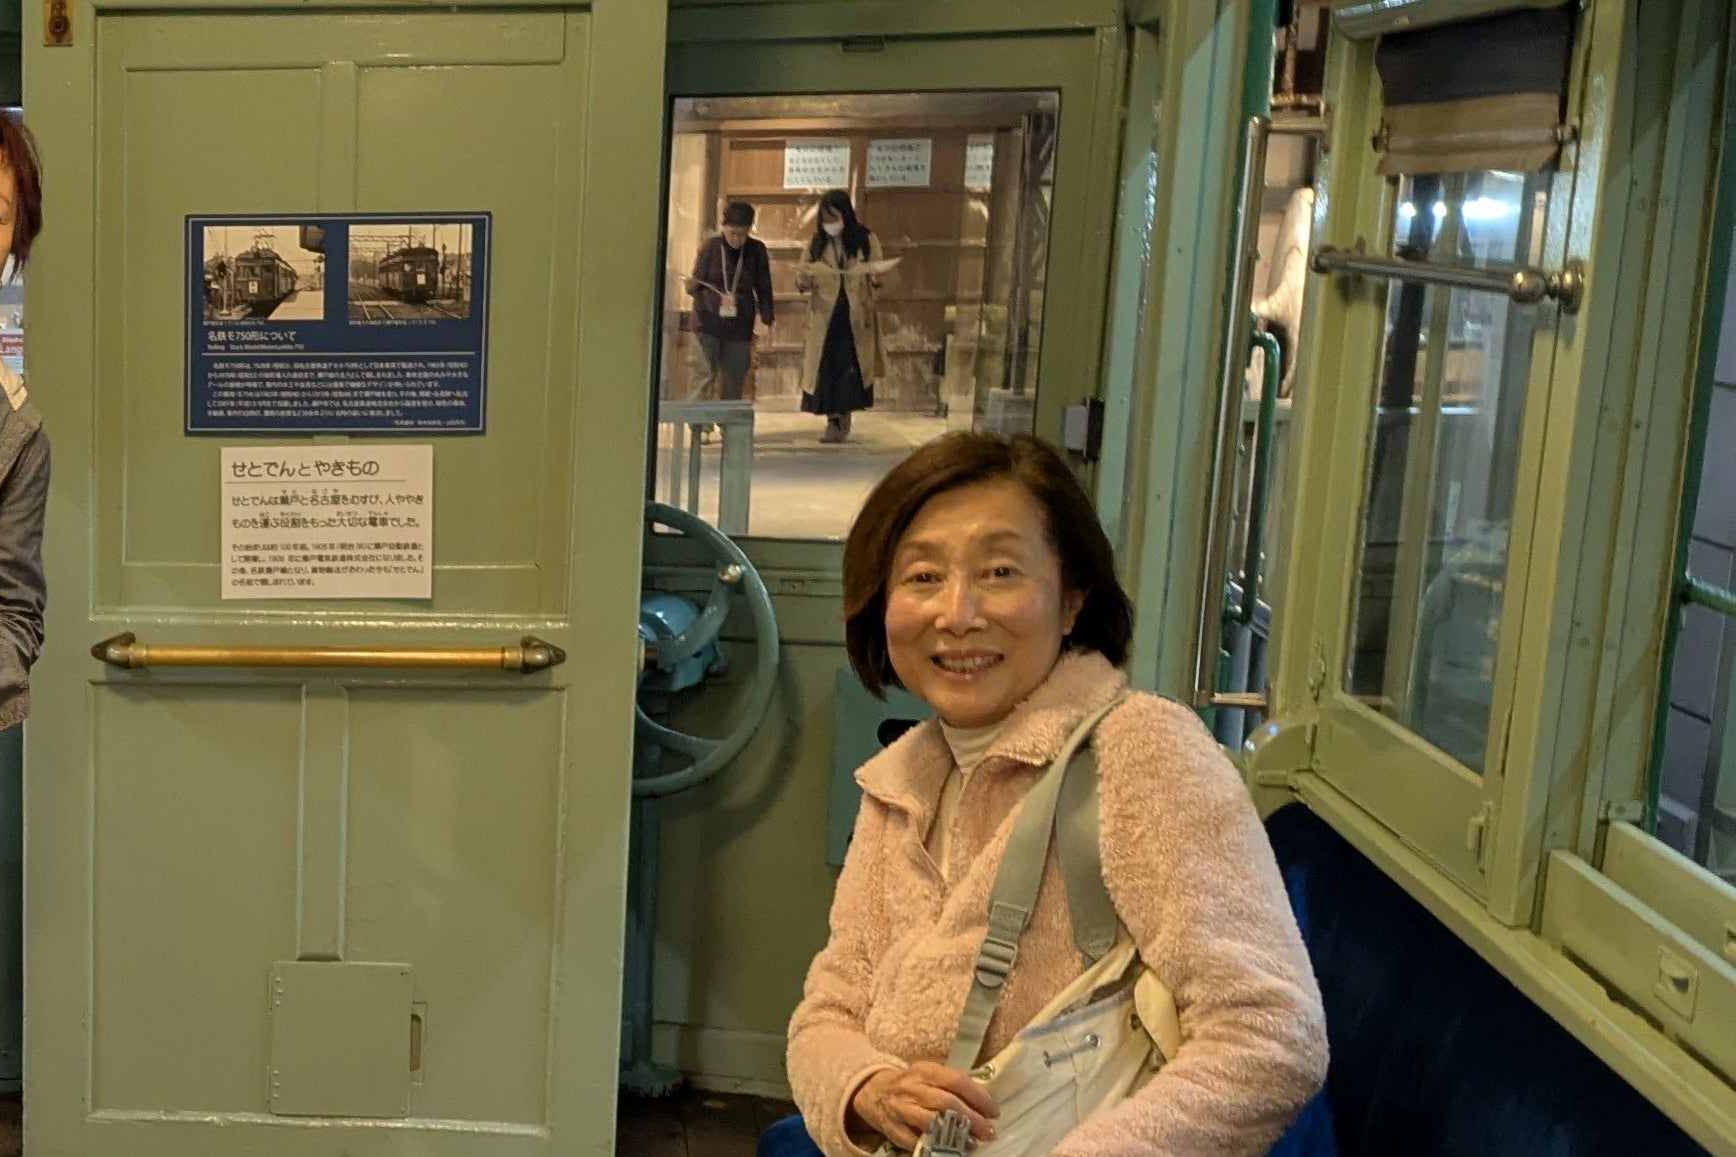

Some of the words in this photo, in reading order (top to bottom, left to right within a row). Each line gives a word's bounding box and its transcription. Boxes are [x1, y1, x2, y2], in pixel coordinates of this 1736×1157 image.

[231, 460, 380, 478] せとでんとやきもの
